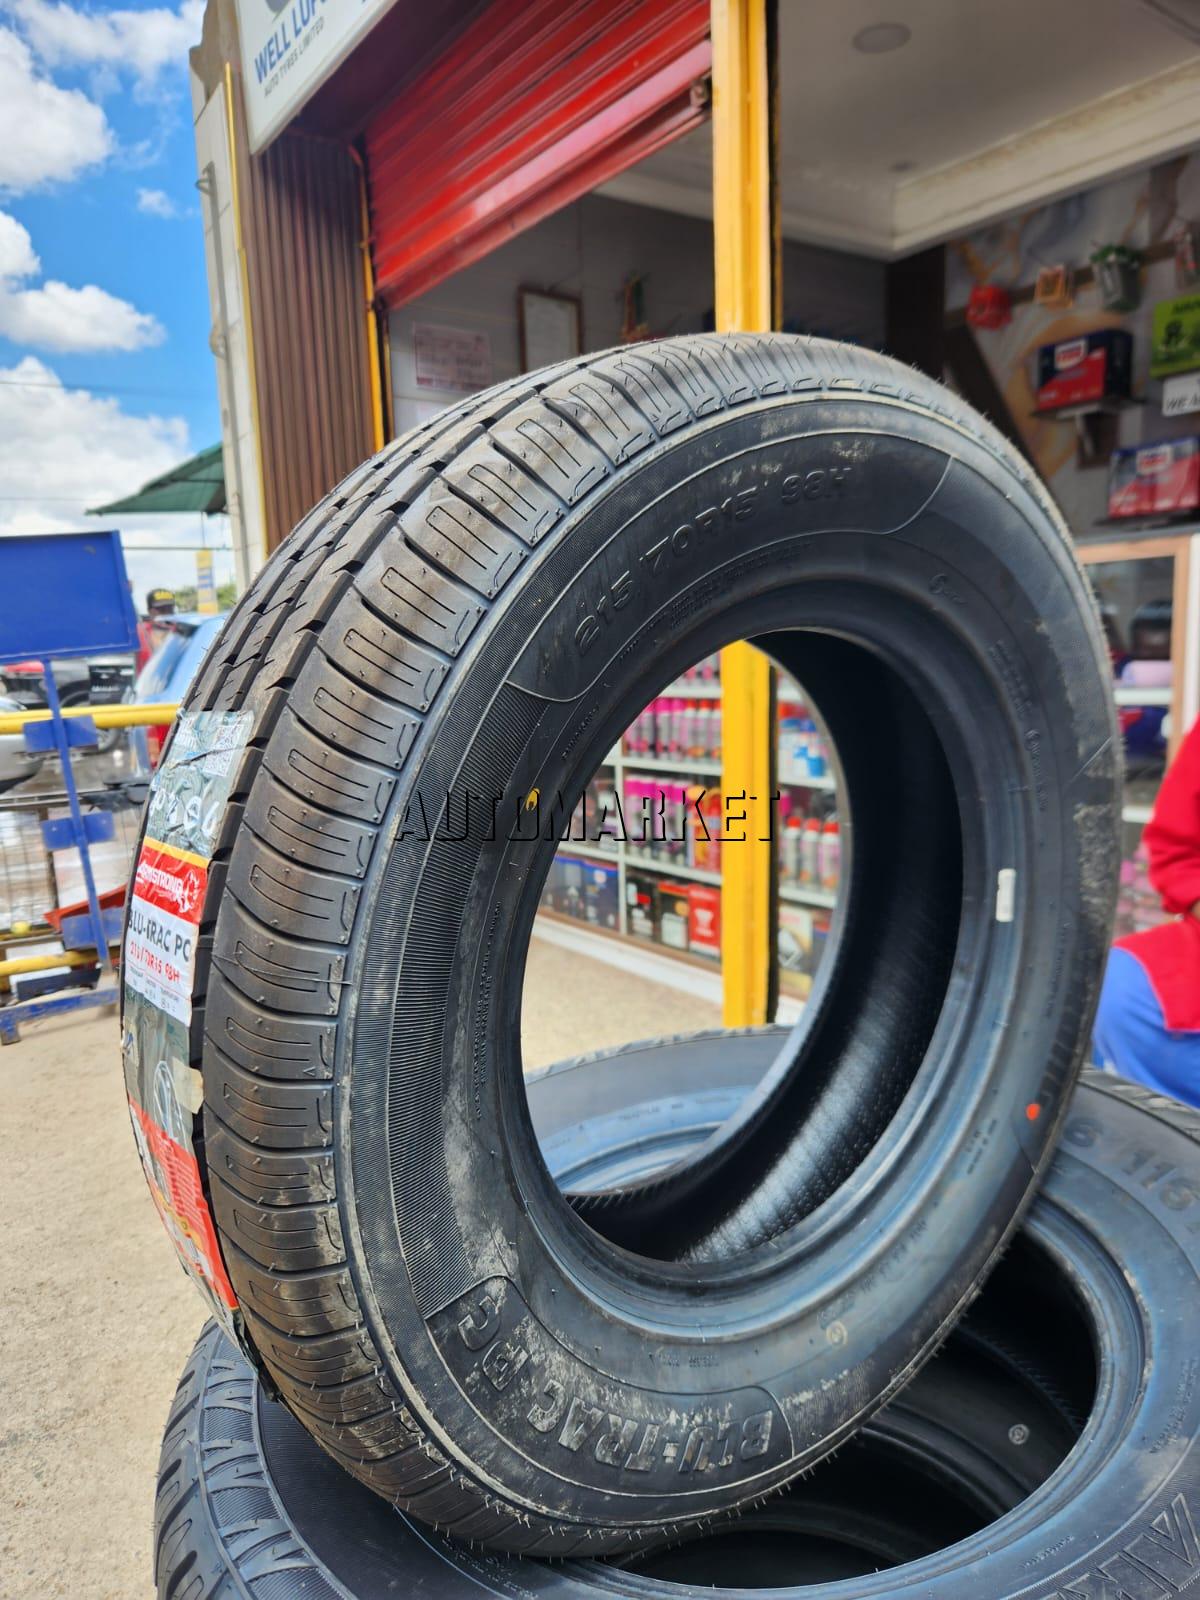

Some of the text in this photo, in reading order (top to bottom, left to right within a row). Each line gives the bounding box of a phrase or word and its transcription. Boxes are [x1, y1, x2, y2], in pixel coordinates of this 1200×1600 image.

[254, 22, 291, 84] WELL
[174, 934, 191, 963] PC
[164, 962, 181, 983] 98H
[526, 1378, 774, 1474] BLU-TRAC
